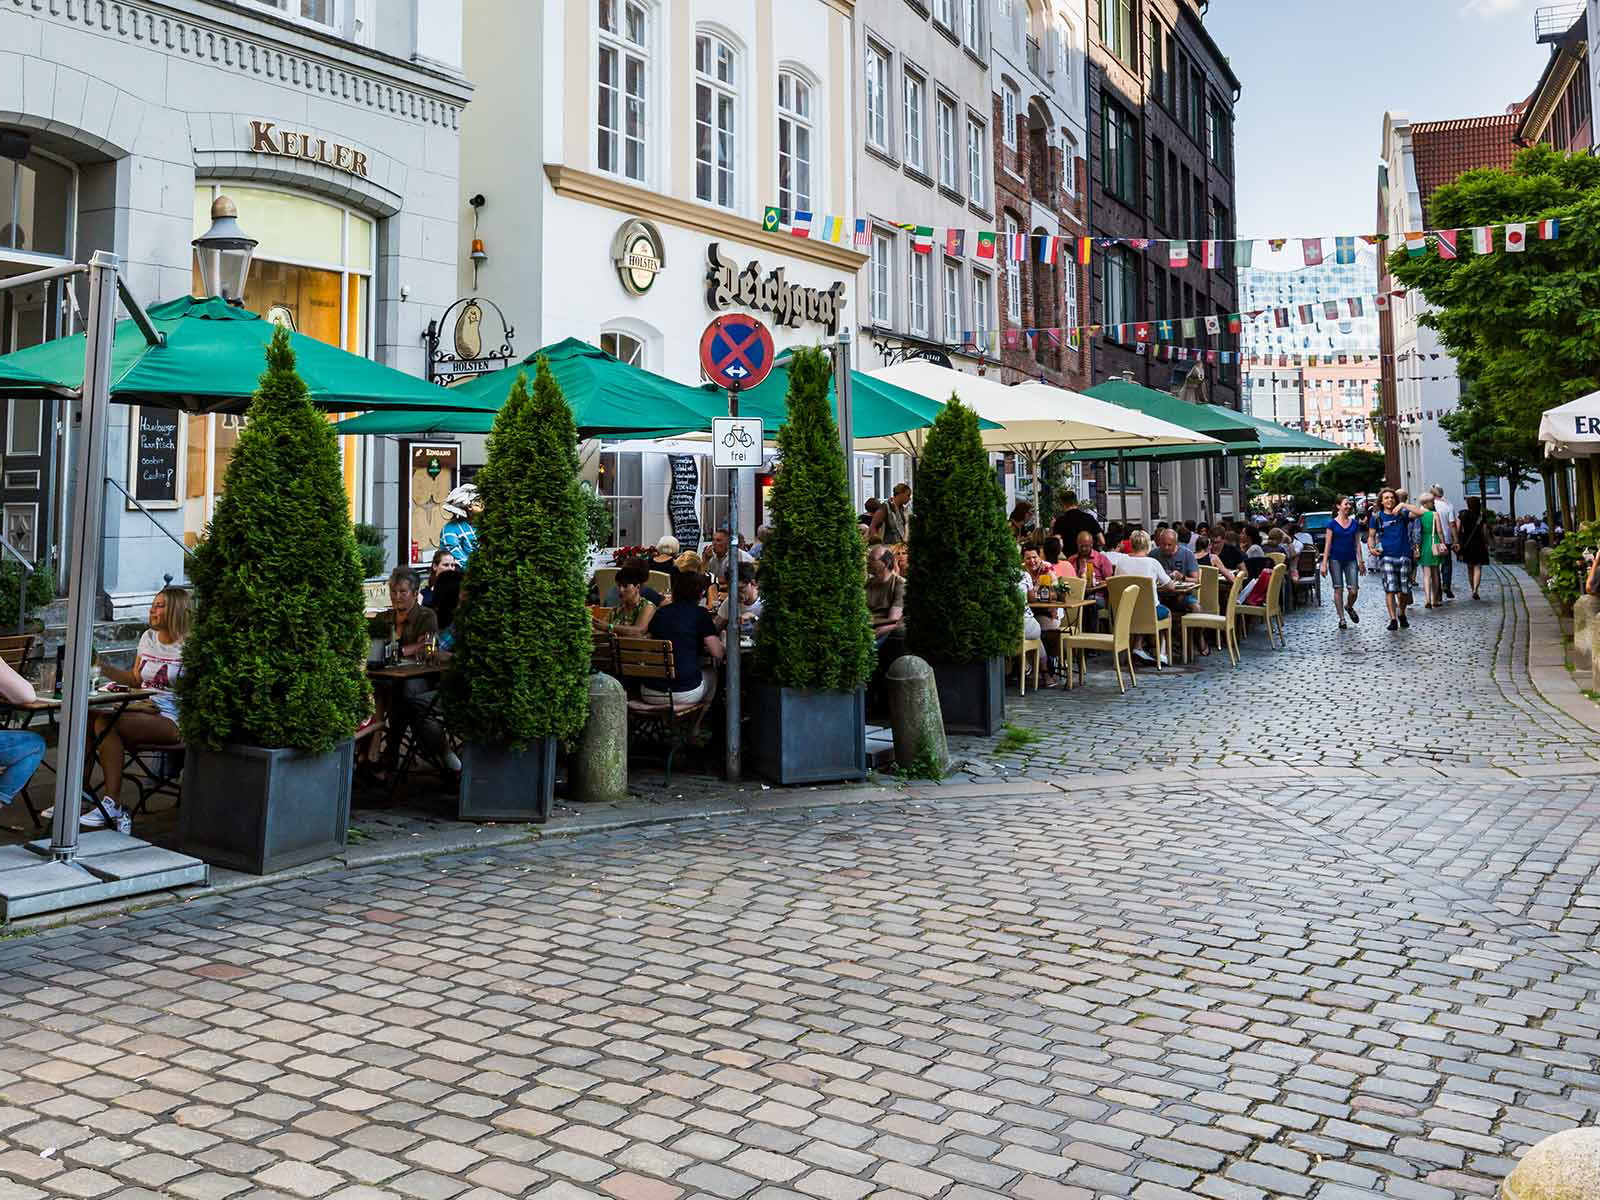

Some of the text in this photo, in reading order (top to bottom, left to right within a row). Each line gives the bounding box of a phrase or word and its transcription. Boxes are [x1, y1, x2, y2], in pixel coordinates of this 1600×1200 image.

[250, 120, 367, 177] KELLER
[629, 255, 658, 271] HOLSTEN
[706, 242, 847, 336] Deichgraf
[453, 360, 489, 372] HOLSTEN
[139, 415, 177, 435] Hamburger
[1575, 415, 1600, 435] ER
[731, 450, 747, 461] frei
